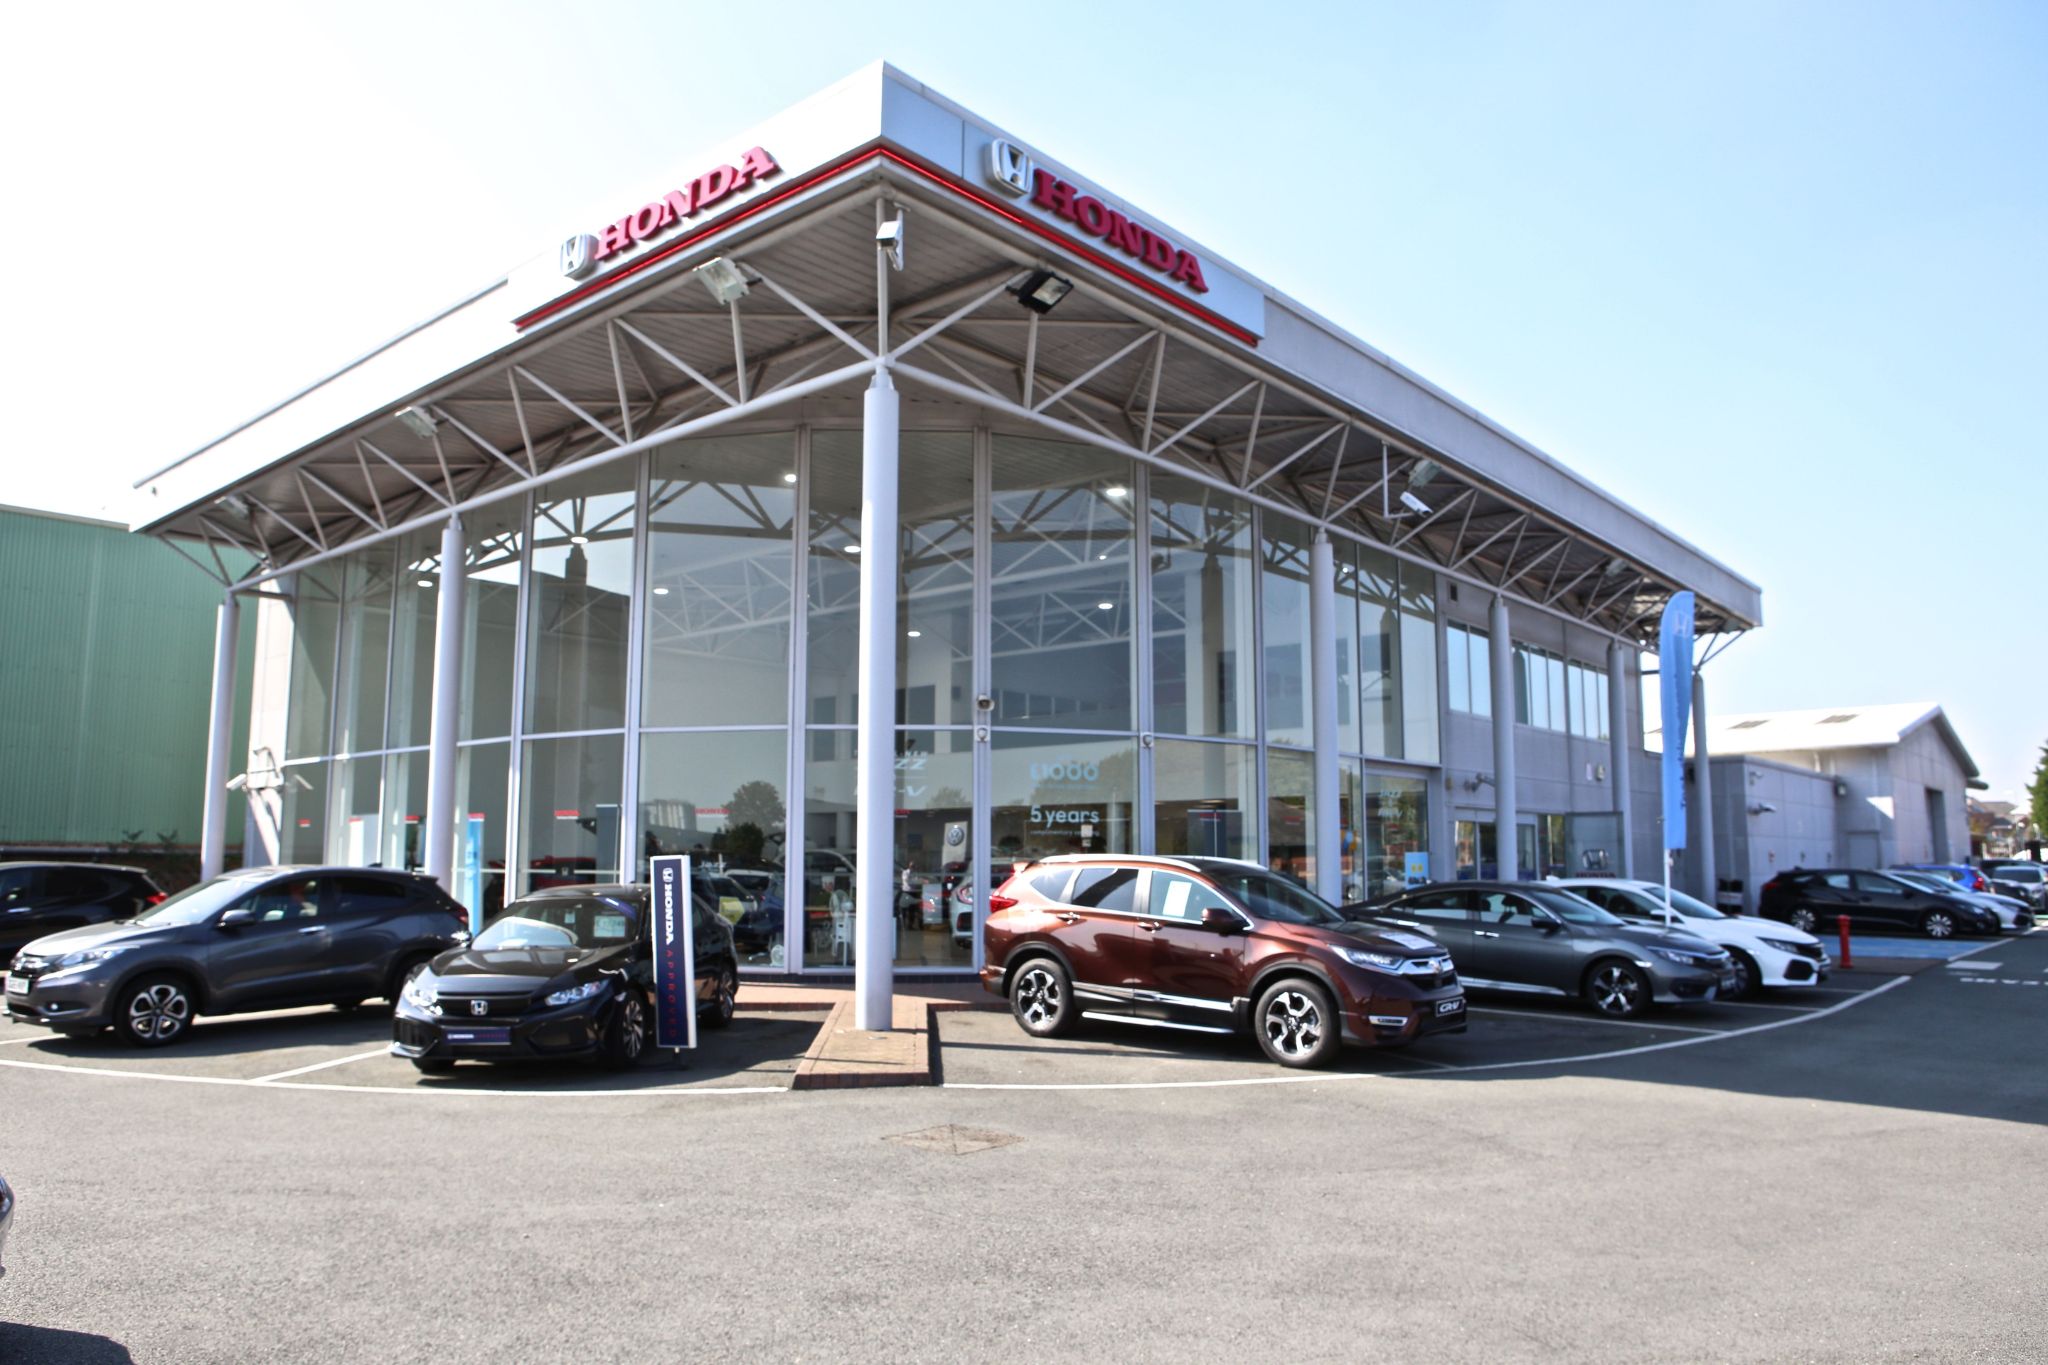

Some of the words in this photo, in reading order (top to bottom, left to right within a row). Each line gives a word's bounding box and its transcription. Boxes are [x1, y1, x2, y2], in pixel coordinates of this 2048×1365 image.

[594, 145, 779, 261] HONDA
[1033, 167, 1209, 293] HONDA
[1030, 804, 1042, 823] 5
[1044, 810, 1100, 829] years
[664, 883, 674, 946] HONDA
[665, 949, 678, 1038] APPROVED
